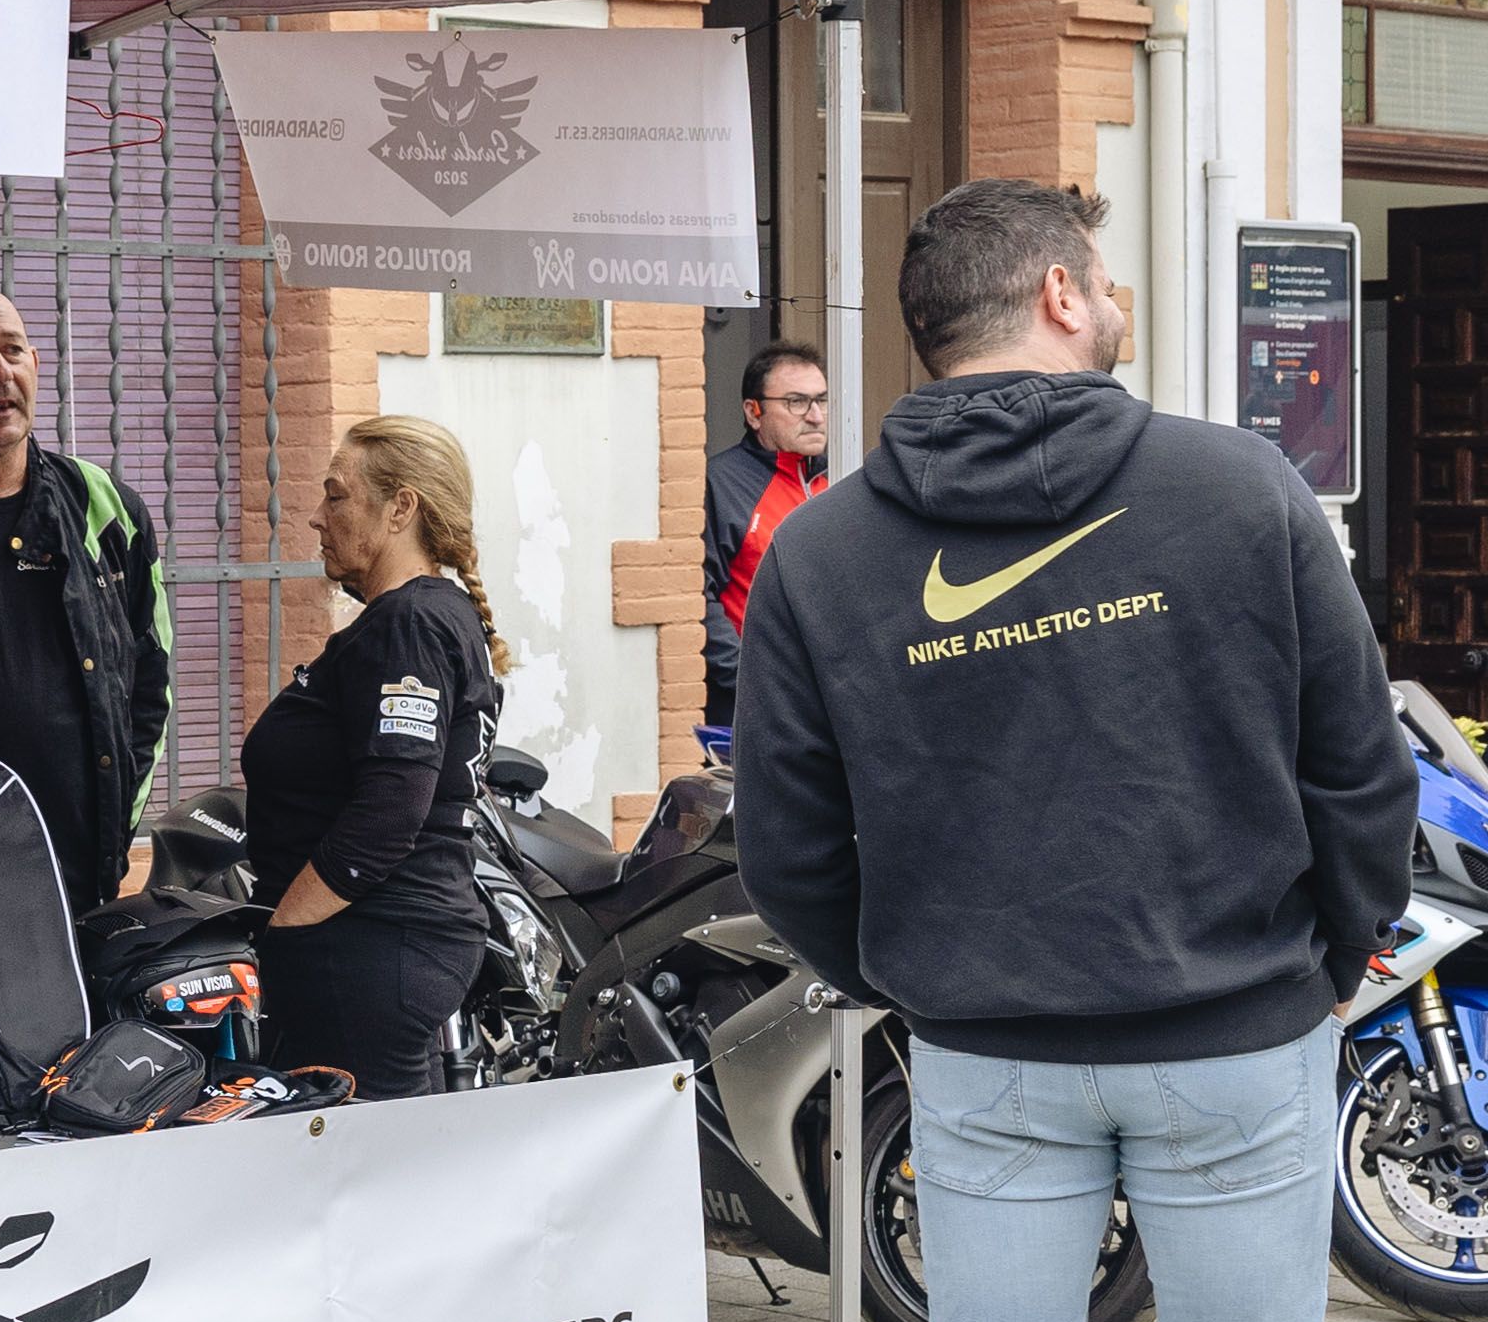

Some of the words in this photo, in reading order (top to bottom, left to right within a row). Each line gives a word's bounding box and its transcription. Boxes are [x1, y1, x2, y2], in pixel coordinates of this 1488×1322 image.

[907, 635, 968, 666] NIKE
[974, 608, 1092, 652] ATHLETIC
[1097, 591, 1169, 623] DEPT.
[395, 720, 434, 735] SANTOS
[190, 808, 246, 844] Kawasaki
[179, 981, 203, 996] SUN
[203, 975, 233, 992] VISOR
